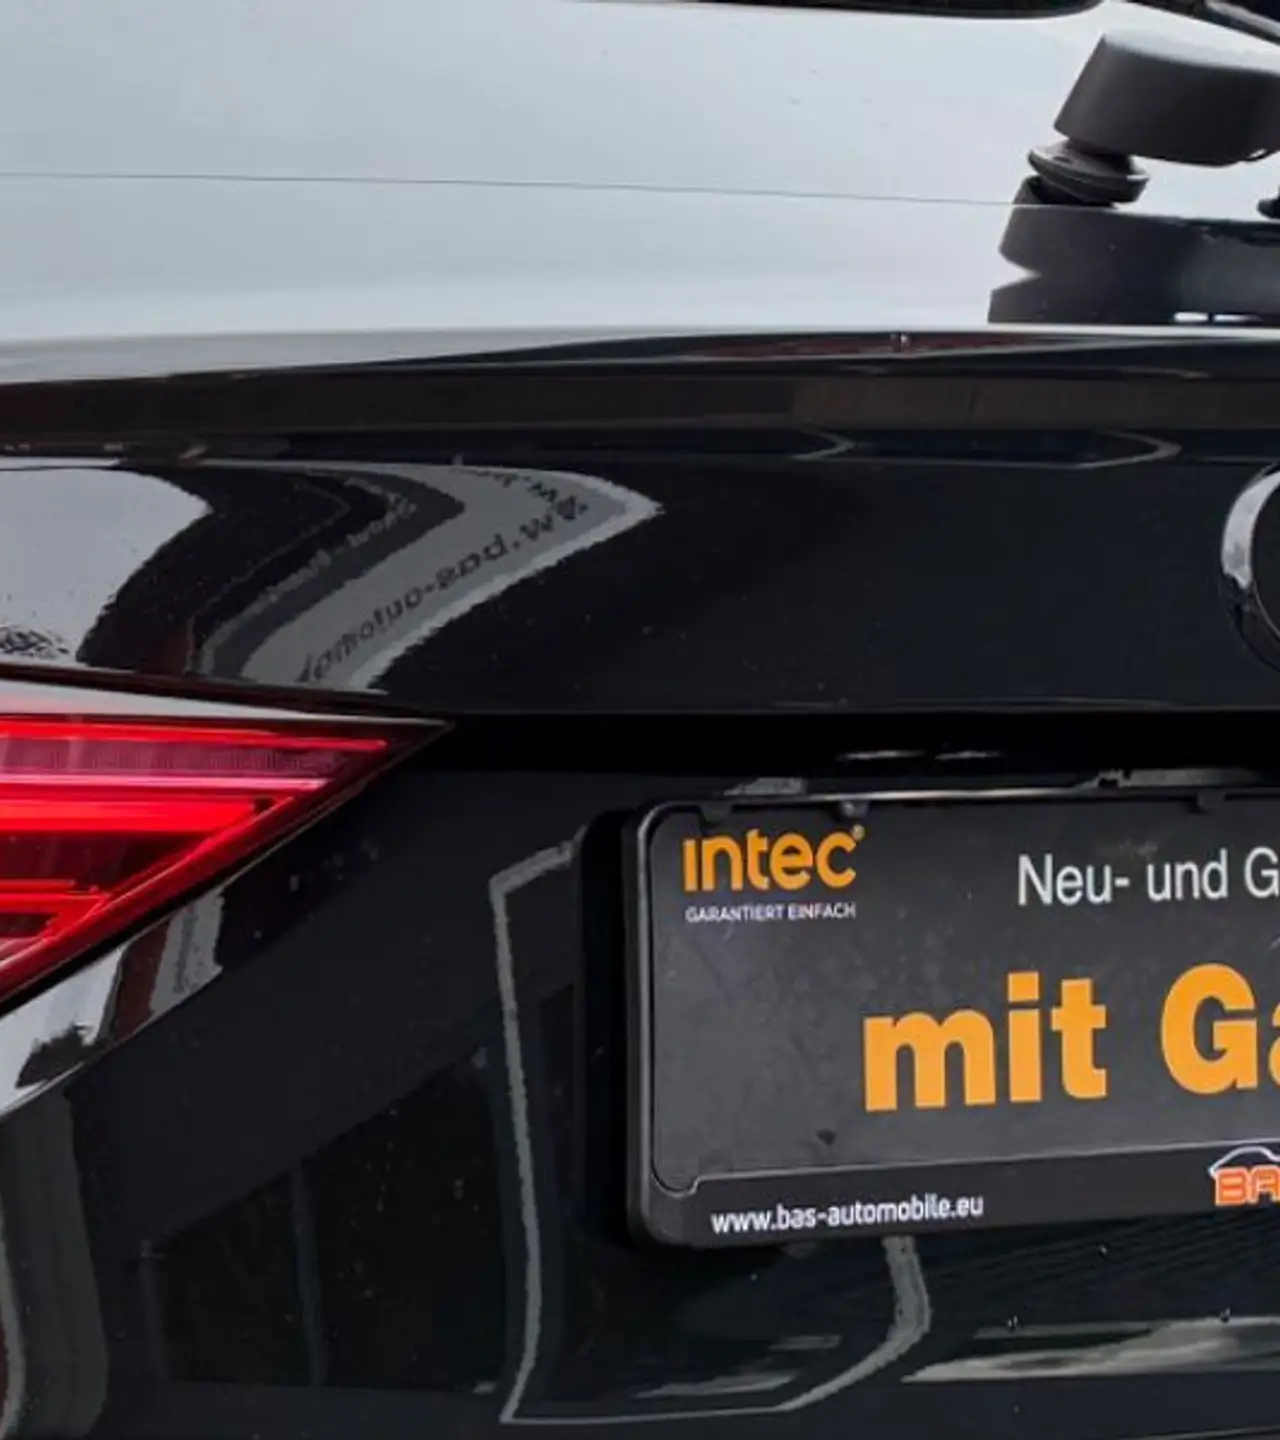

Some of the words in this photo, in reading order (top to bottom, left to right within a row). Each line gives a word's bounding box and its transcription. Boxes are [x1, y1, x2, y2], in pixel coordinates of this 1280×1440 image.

[1018, 853, 1130, 906] Neu-
[1146, 848, 1228, 901] und
[685, 903, 784, 923] GARANTIERT
[787, 901, 856, 920] EINFACH
[863, 970, 1108, 1112] mit
[1161, 963, 1280, 1094] G
[711, 1193, 984, 1234] www.bas-automobile.eu
